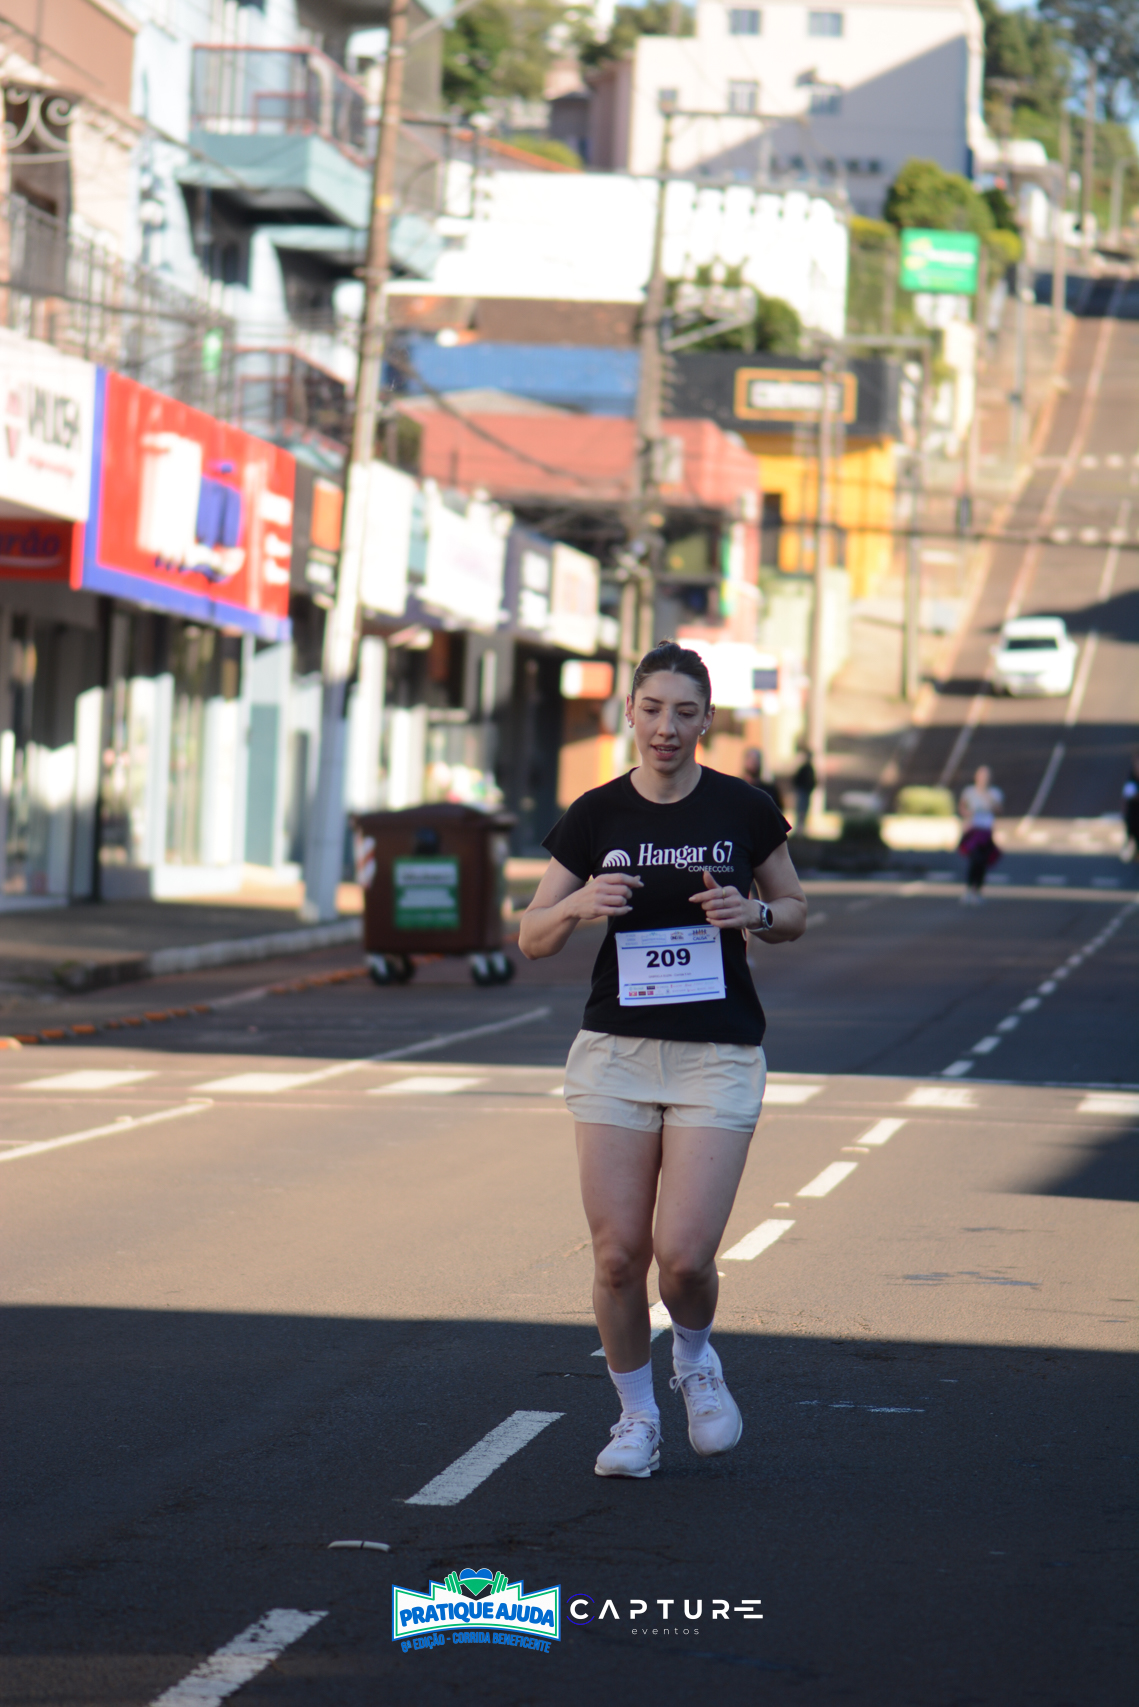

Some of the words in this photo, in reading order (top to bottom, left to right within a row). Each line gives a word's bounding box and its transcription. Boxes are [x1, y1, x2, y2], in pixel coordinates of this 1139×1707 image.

[0, 526, 60, 557] rdo
[637, 843, 707, 869] Hangar
[712, 841, 733, 864] 67
[646, 948, 691, 968] 209
